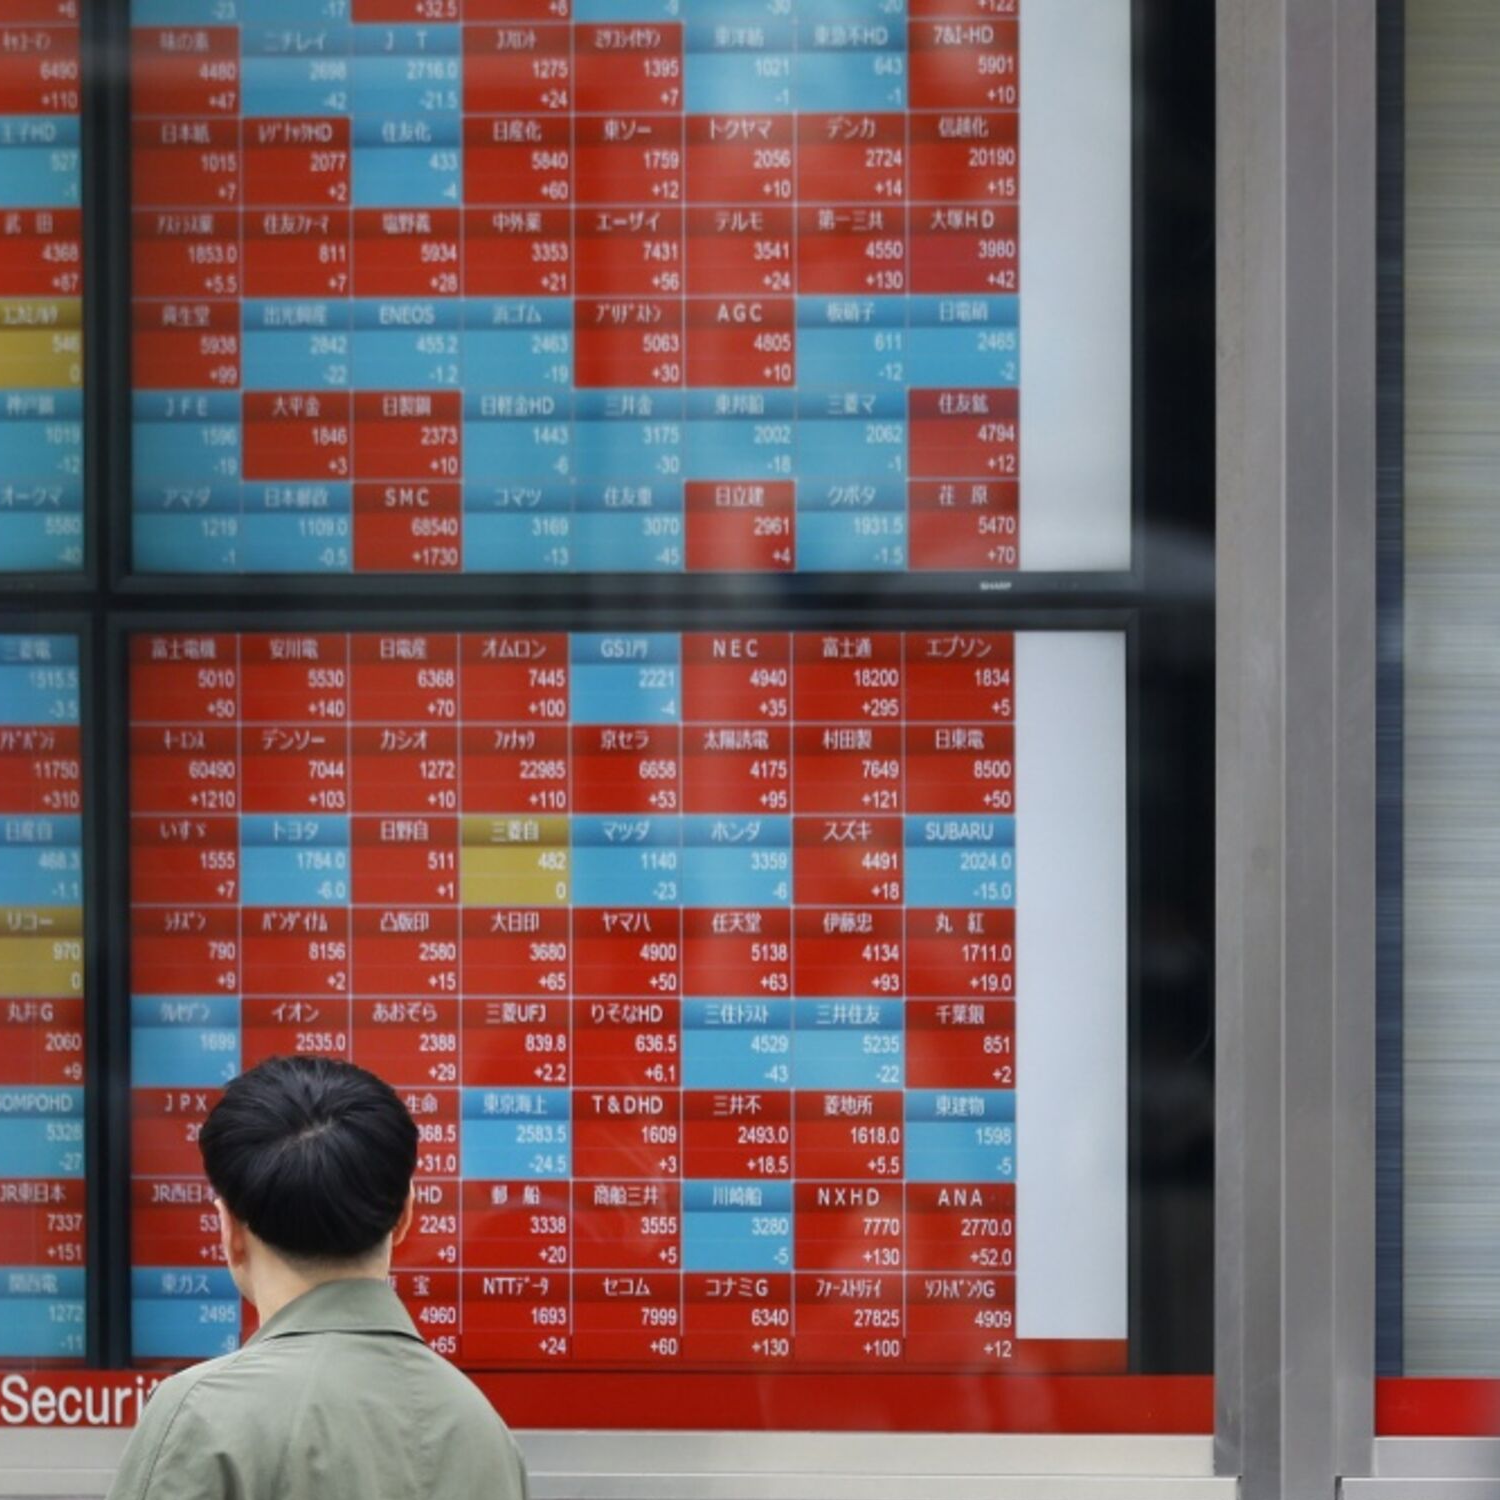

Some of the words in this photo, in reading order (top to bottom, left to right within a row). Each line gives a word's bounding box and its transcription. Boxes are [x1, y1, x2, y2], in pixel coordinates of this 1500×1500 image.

[642, 58, 679, 77] 1395
[976, 55, 1015, 76] 5901
[988, 85, 1015, 104] +10
[710, 119, 772, 139] トクヤマ
[642, 149, 680, 169] 1759
[866, 148, 902, 167] 2724
[969, 147, 1016, 166] 20190
[652, 180, 680, 199] +12
[876, 179, 903, 196] +14
[988, 177, 1015, 196] +15
[714, 212, 764, 232] テルモ
[817, 210, 883, 230] 第一三共
[534, 244, 568, 261] 3353
[644, 241, 678, 261] 7431
[754, 241, 789, 261] 3541
[866, 240, 903, 260] 4550
[764, 271, 790, 291] +24
[866, 270, 904, 289] +130
[988, 270, 1015, 288] +42
[380, 307, 434, 325] ENEOS
[717, 303, 762, 322] AGC
[421, 426, 458, 445] 2373
[978, 424, 1015, 442] 4794
[987, 454, 1015, 472] +12
[385, 488, 429, 506] SMC
[752, 516, 789, 537] 2961
[978, 515, 1016, 534] 5470
[413, 547, 459, 566] +1730
[988, 546, 1016, 564] +70
[481, 638, 547, 659] オムロン
[712, 639, 757, 657] NEC
[823, 637, 872, 656] 富士通
[927, 636, 992, 657] エプソン
[309, 668, 345, 688] 5530
[529, 669, 565, 687] 7445
[751, 668, 787, 687] 4940
[975, 668, 1010, 687] 1834
[307, 699, 345, 718] +140
[530, 698, 566, 718] +100
[760, 698, 787, 717] +35
[264, 730, 326, 750] デンソー
[381, 729, 428, 750] カシオ
[601, 729, 650, 749] 京セラ
[309, 760, 344, 779] 7044
[420, 760, 455, 779] 1272
[750, 760, 788, 778] 4175
[862, 760, 899, 779] 7649
[974, 760, 1011, 778] 8500
[188, 790, 236, 808] +1210
[530, 790, 566, 808] +110
[862, 790, 898, 808] +121
[984, 790, 1012, 808] +50
[824, 820, 872, 840] スズキ
[926, 821, 994, 841] SUBARU
[201, 850, 236, 869] 1555
[428, 851, 454, 870] 511
[862, 851, 897, 870] 4491
[490, 912, 540, 931] 大日印
[602, 913, 651, 932] ヤマハ
[712, 913, 761, 933] 任天堂
[823, 912, 872, 933] 伊藤忠
[210, 942, 236, 960] 790
[640, 942, 677, 961] 4900
[751, 942, 788, 961] 5138
[862, 944, 899, 961] 4134
[962, 943, 1012, 961] 1711.0
[970, 974, 1012, 992] +19.0
[273, 1003, 319, 1022] イオン
[372, 1002, 437, 1022] あおぞら
[297, 1032, 346, 1051] 2535.0
[635, 1034, 677, 1052] 636.5
[983, 1035, 1010, 1053] 851
[427, 1063, 457, 1082] +29
[534, 1063, 566, 1082] +2.2
[713, 1095, 762, 1115] 三井不
[642, 1125, 677, 1143] 1609
[738, 1126, 789, 1144] 2493.0
[745, 1156, 790, 1174] +18.5
[594, 1185, 658, 1205] 商船三井
[818, 1188, 880, 1207] NXHD
[938, 1189, 983, 1206] ANA
[48, 1214, 82, 1231] 7337
[420, 1216, 456, 1233] 2243
[531, 1216, 567, 1233] 3338
[642, 1216, 677, 1235] 3555
[864, 1219, 901, 1236] 7770
[961, 1218, 1012, 1236] 2770.0
[970, 1248, 1012, 1266] +52.0
[602, 1278, 650, 1295] セコム
[707, 1278, 769, 1296] コナミG
[532, 1307, 567, 1325] 1693
[642, 1307, 677, 1326] 7999
[751, 1309, 789, 1326] 6340
[854, 1309, 900, 1327] 27825
[975, 1310, 1012, 1328] 4909
[864, 1339, 900, 1357] +100
